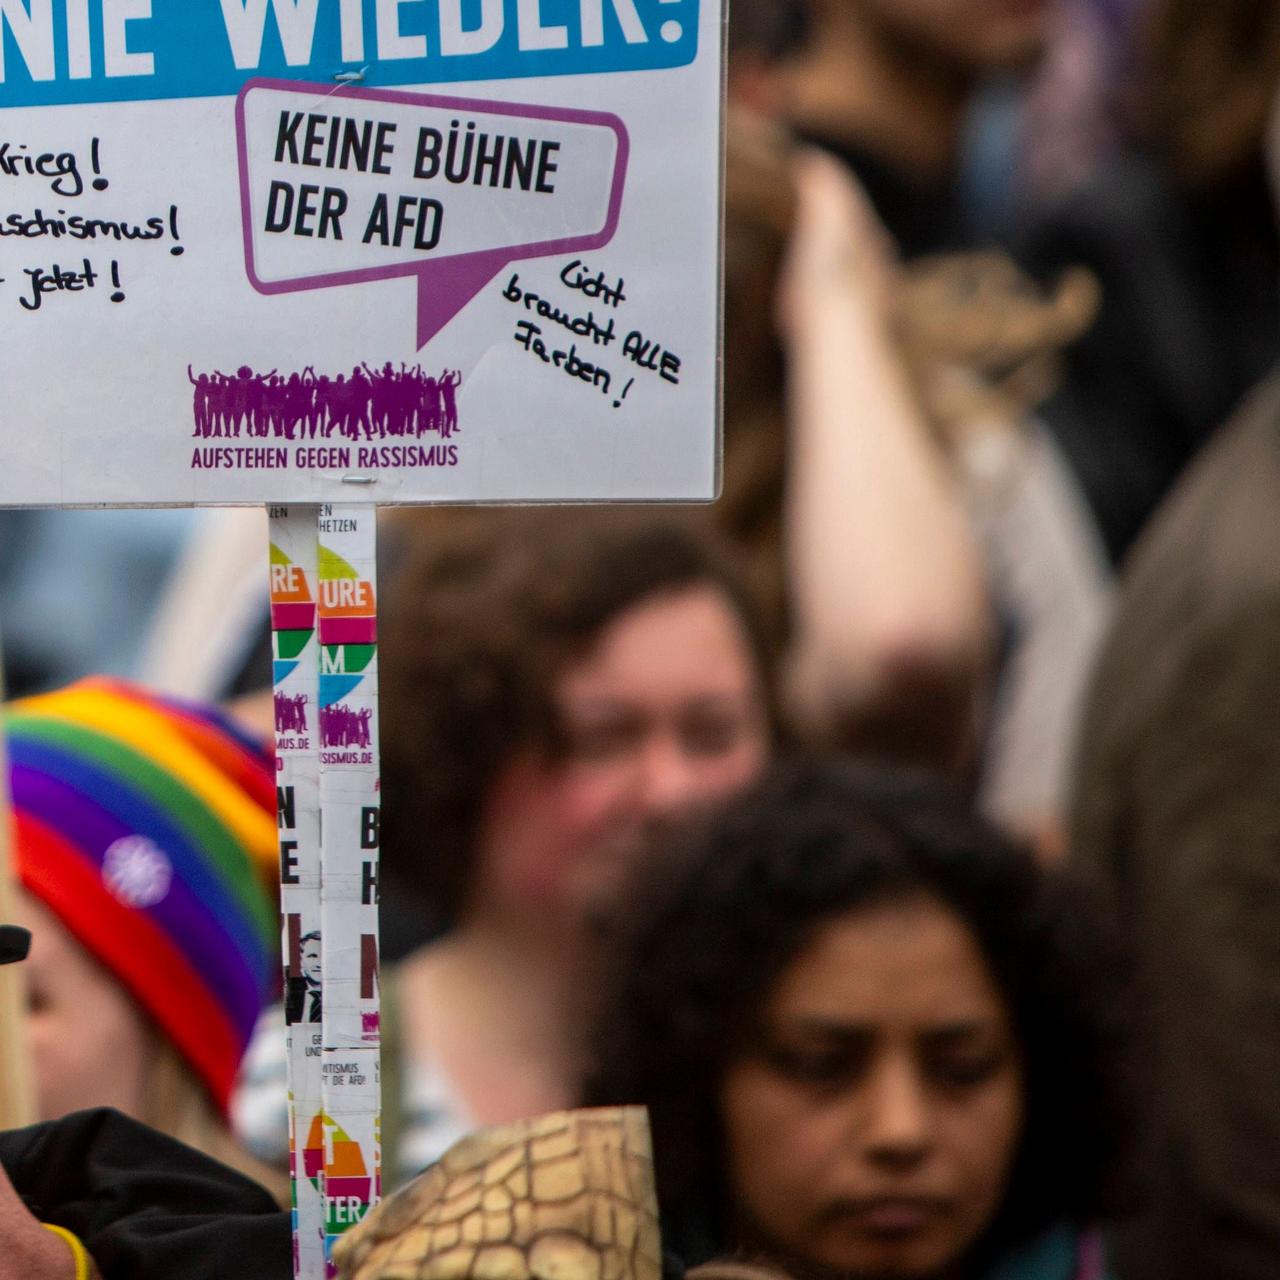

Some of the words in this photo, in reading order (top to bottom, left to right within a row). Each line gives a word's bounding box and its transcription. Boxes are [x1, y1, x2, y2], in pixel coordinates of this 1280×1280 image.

[274, 110, 398, 175] KEINE
[413, 119, 561, 194] BÜHNE
[264, 180, 349, 241] DER
[362, 192, 445, 251] AFD
[502, 273, 616, 346] braucht
[622, 330, 682, 385] ALLE
[190, 447, 289, 469] AUFSTEHEN
[295, 447, 350, 469] GEGEN
[357, 444, 459, 468] RASSISMUS
